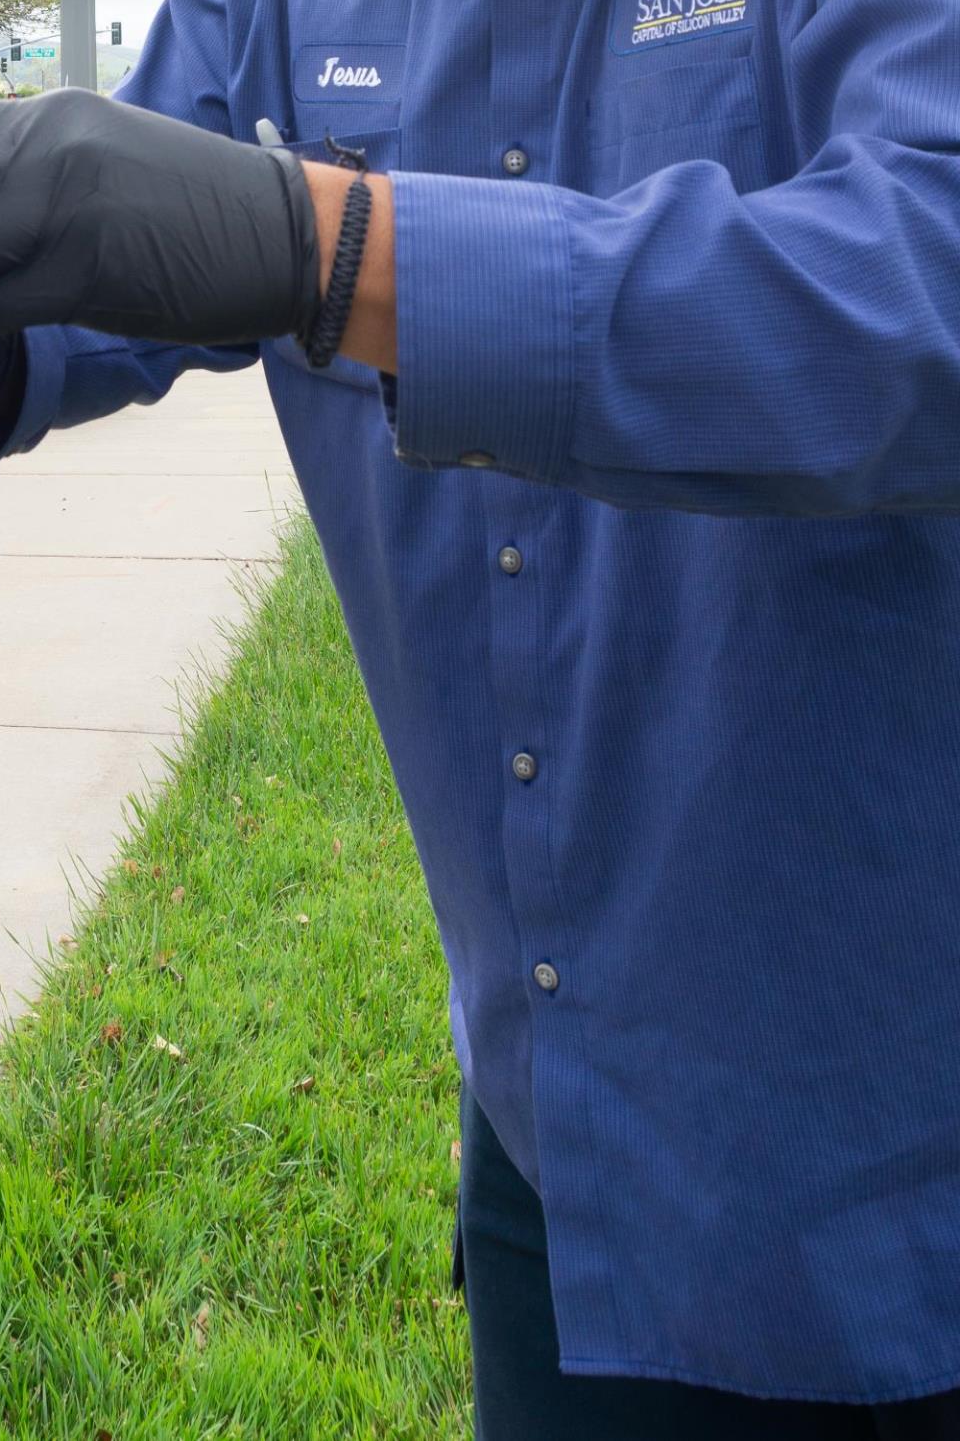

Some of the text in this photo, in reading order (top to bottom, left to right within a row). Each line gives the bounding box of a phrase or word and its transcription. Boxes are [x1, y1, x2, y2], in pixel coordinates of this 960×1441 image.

[632, 6, 746, 44] CAPITAL OF SILICON VALLEY
[318, 57, 381, 88] Jesus
